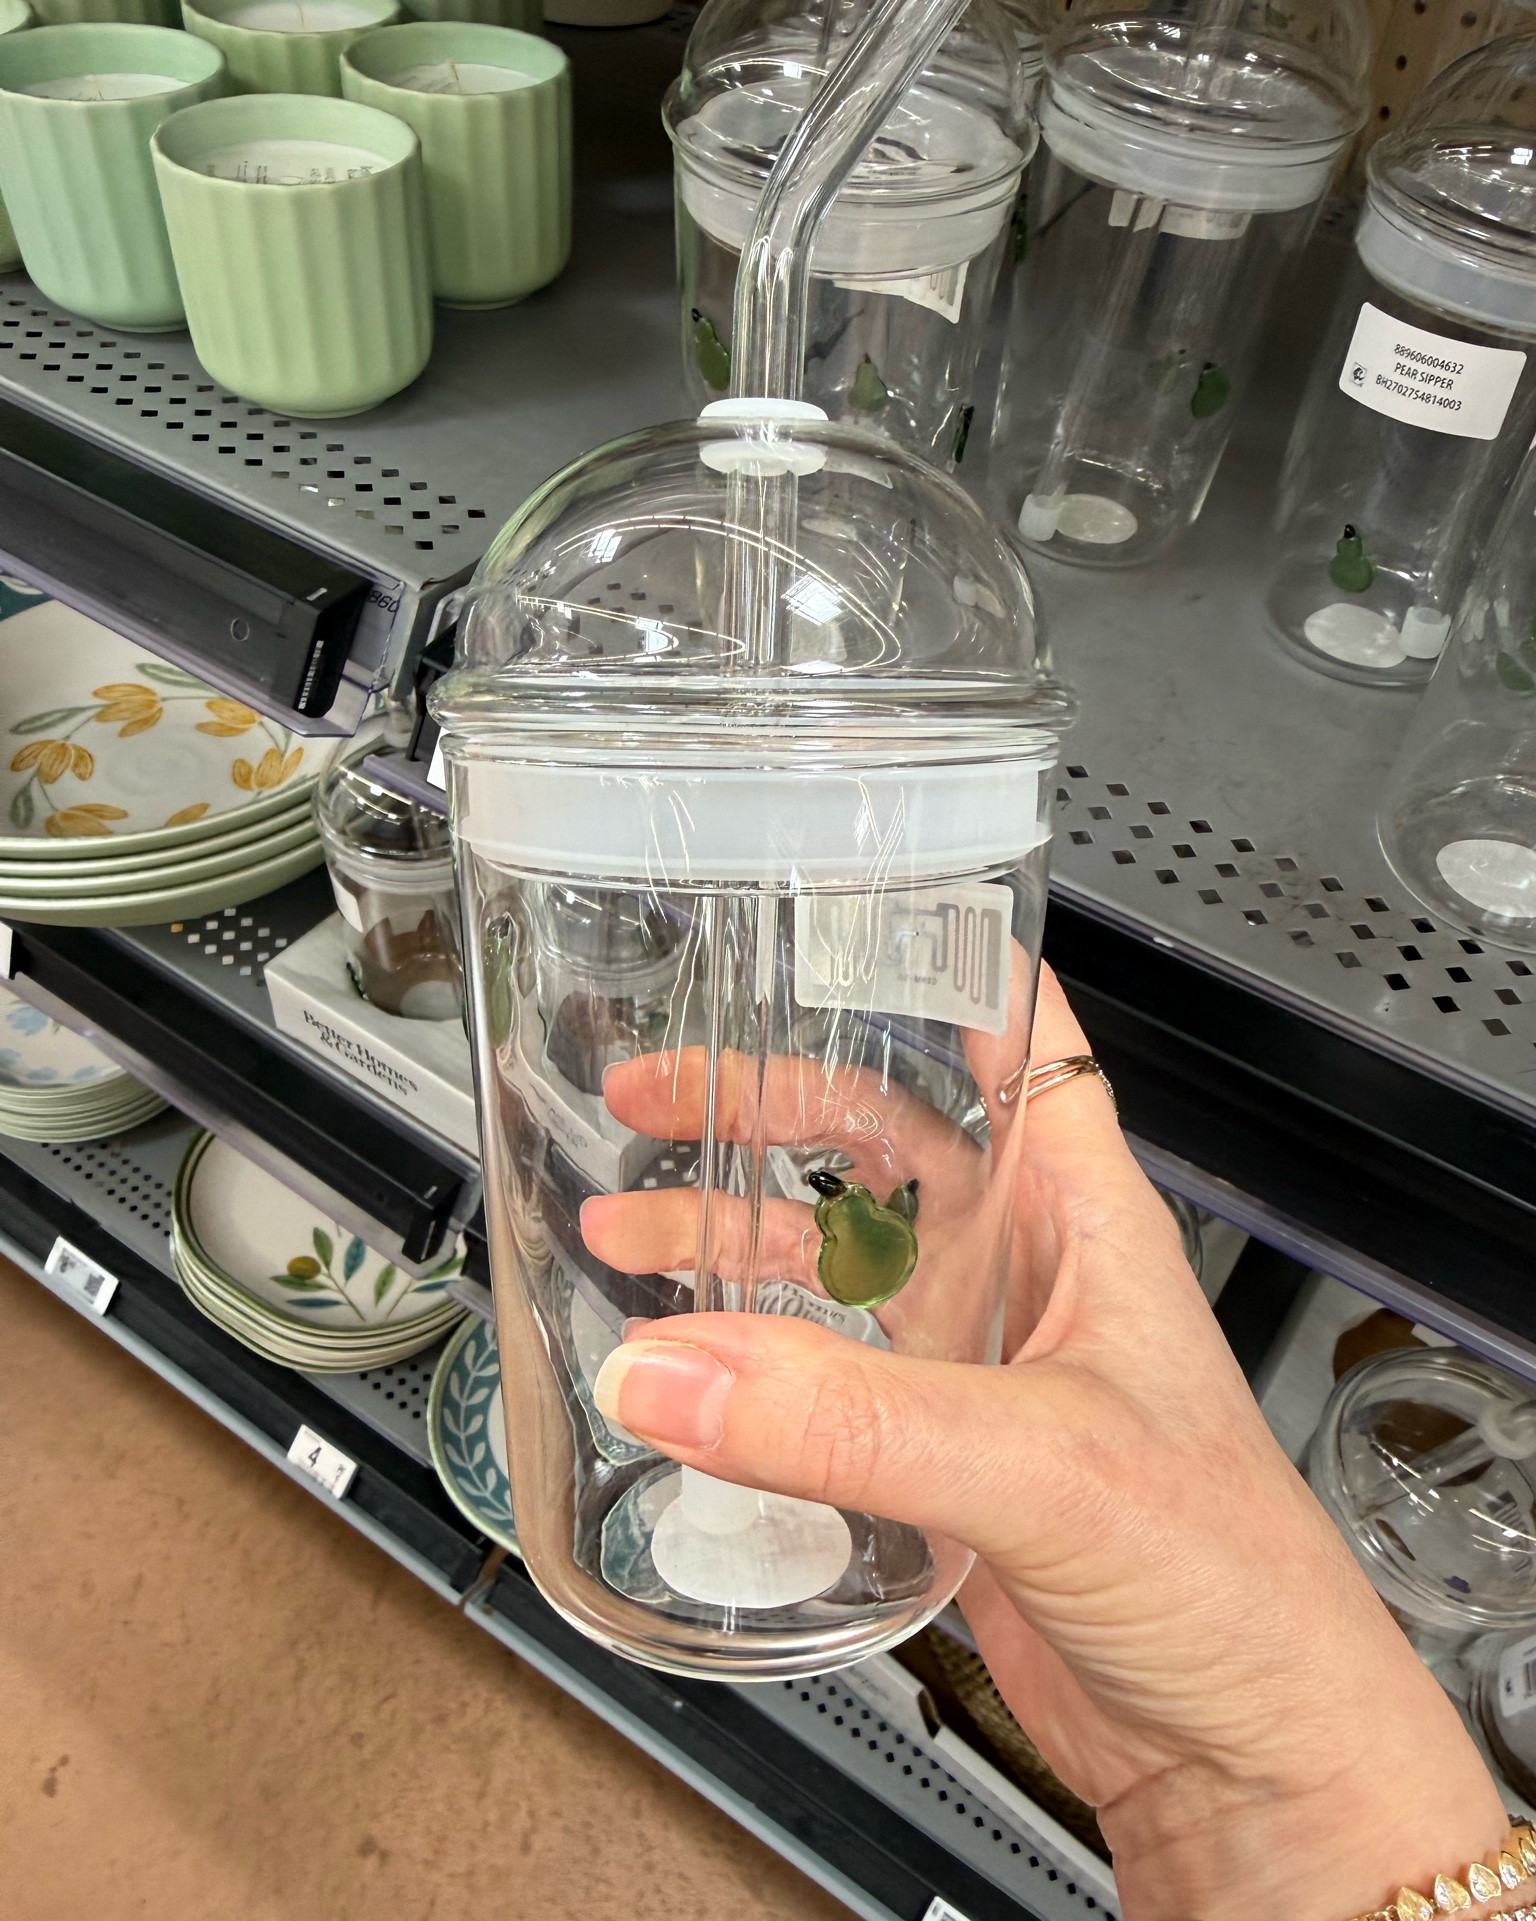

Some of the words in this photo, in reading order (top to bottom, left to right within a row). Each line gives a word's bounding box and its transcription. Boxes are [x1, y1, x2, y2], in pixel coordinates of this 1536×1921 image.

[1394, 343, 1464, 375] 889606004632
[1394, 362, 1418, 380] PEAR
[1418, 371, 1454, 390] SIPPER
[303, 1010, 354, 1048] Better
[356, 1043, 418, 1092] Homes
